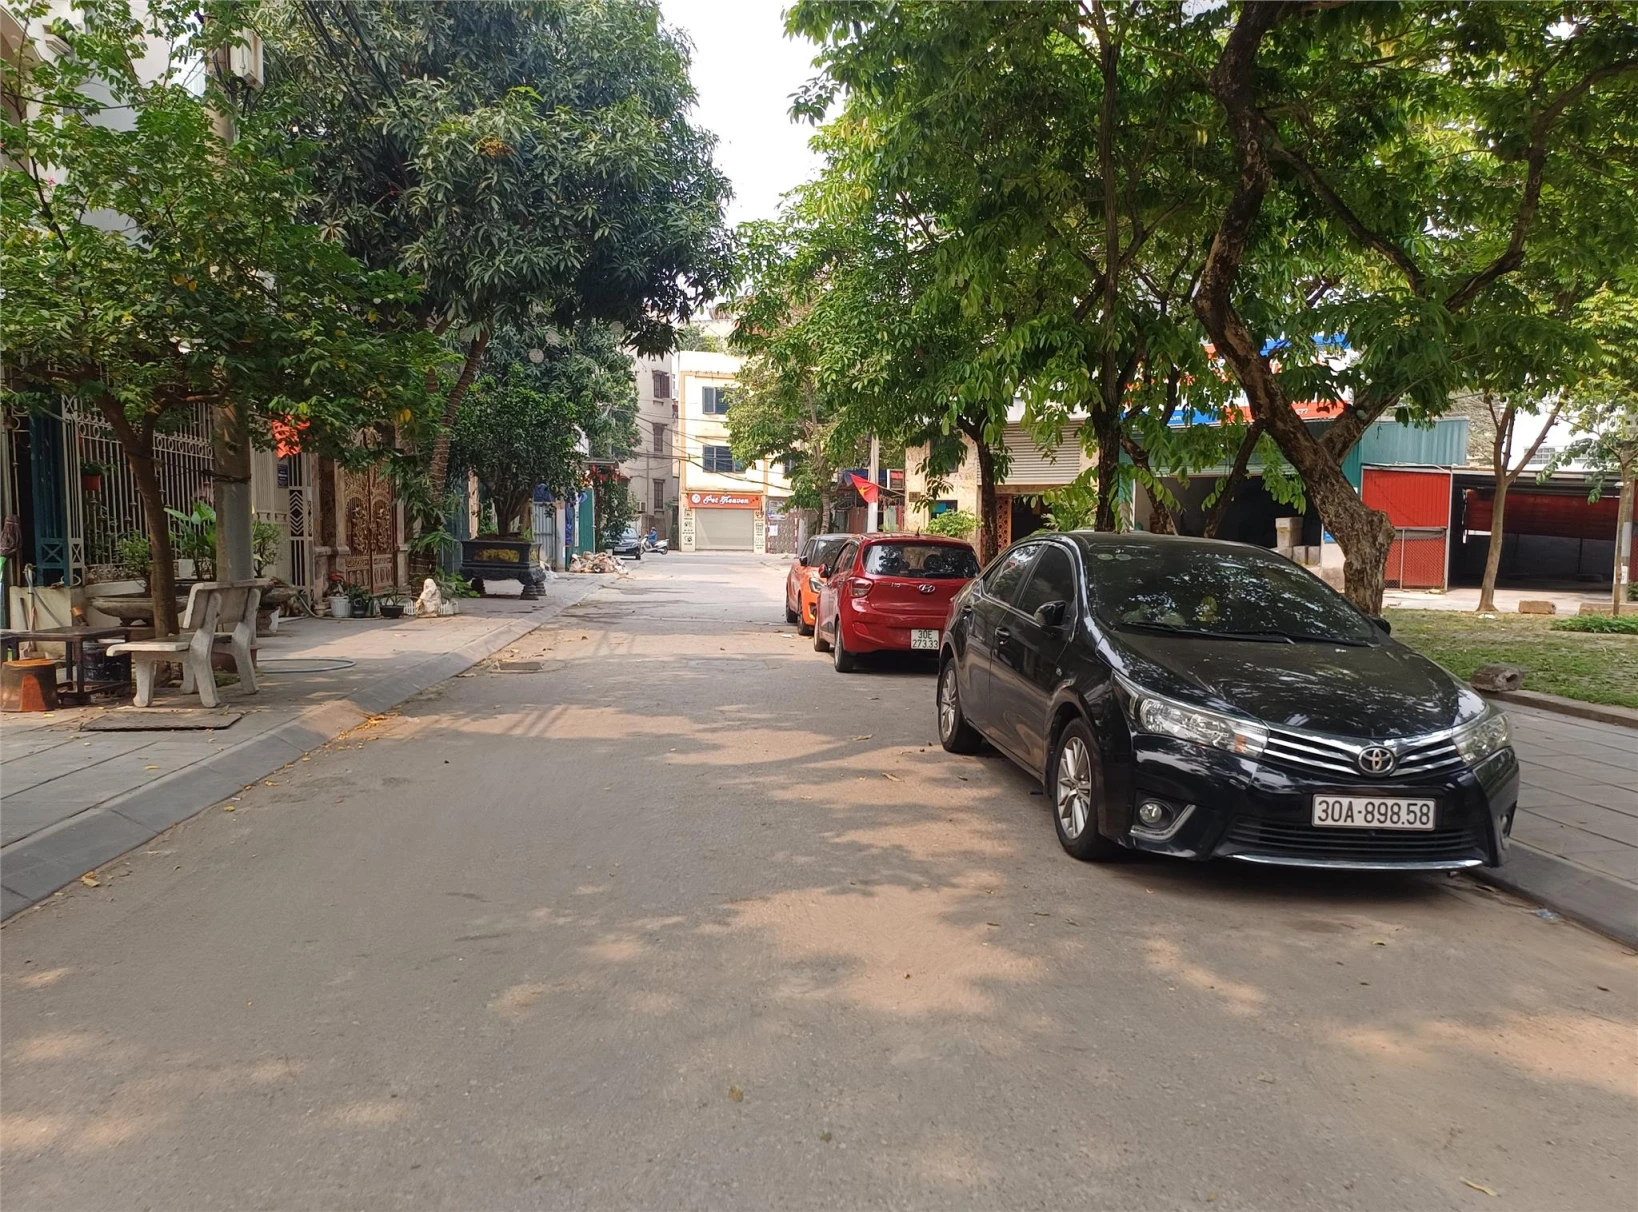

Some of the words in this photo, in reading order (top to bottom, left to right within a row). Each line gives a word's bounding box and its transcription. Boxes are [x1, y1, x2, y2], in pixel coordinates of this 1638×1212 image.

[703, 494, 718, 504] Pet
[720, 495, 749, 504] Heaven
[918, 630, 933, 639] 30E
[912, 639, 938, 649] 273.33
[1317, 800, 1431, 825] 30A-898.58
